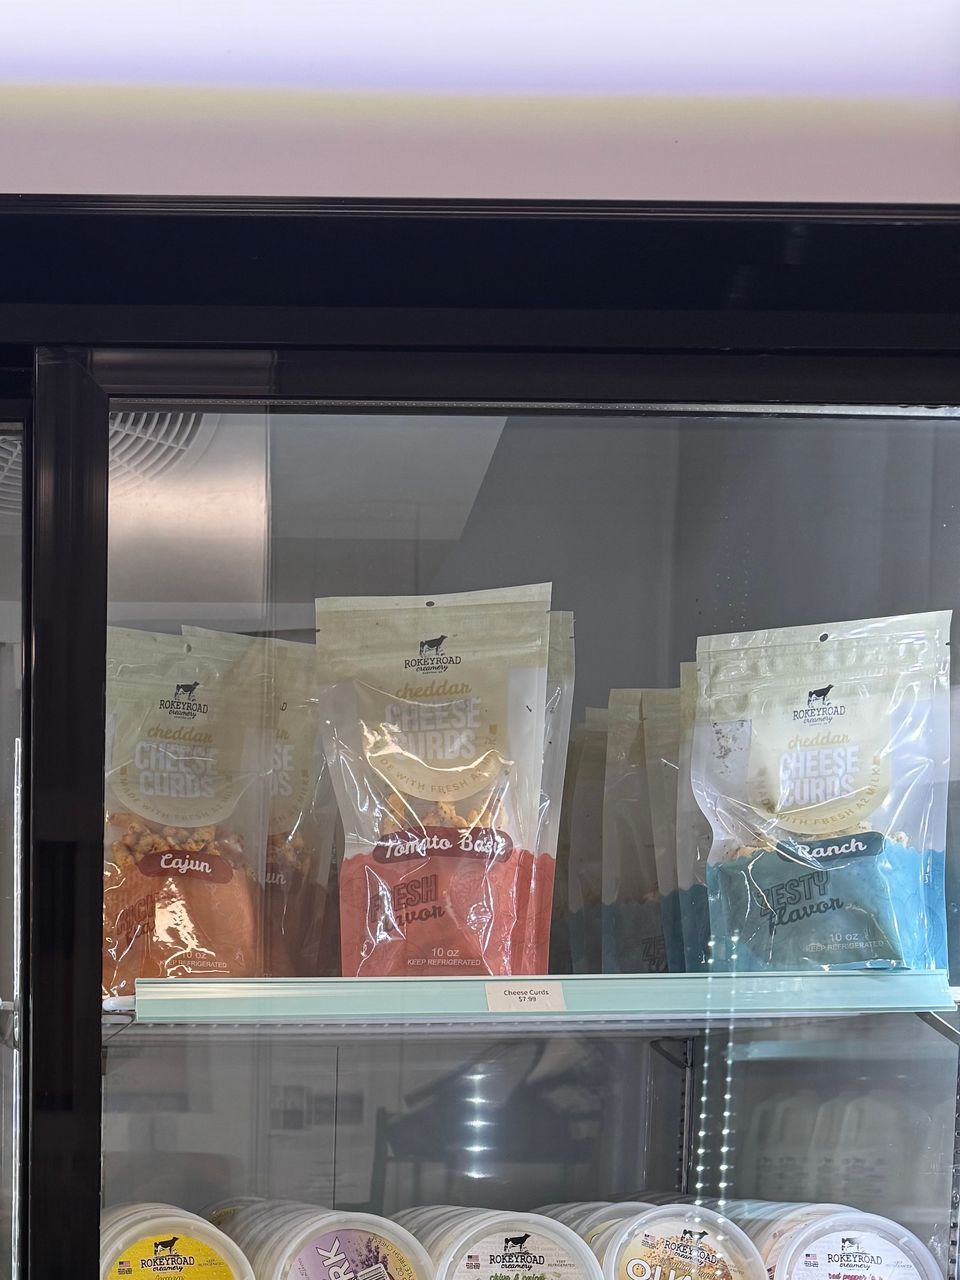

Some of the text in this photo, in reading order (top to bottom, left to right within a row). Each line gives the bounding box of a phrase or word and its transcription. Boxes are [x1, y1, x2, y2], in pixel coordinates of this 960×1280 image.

[404, 656, 461, 670] ROKEYROAD
[160, 699, 208, 714] ROKEYROAD
[792, 705, 846, 720] ROKEYROAD
[780, 745, 859, 779] CHEESE
[796, 839, 867, 860] Ranch
[160, 853, 212, 874] Cajun
[757, 870, 830, 918] ZESTY
[428, 958, 481, 966] REFRIGERATED
[141, 1256, 195, 1268] ROKEYROAD
[489, 1254, 544, 1265] ROKEYROAD
[827, 1254, 882, 1264] ROKEYROAD
